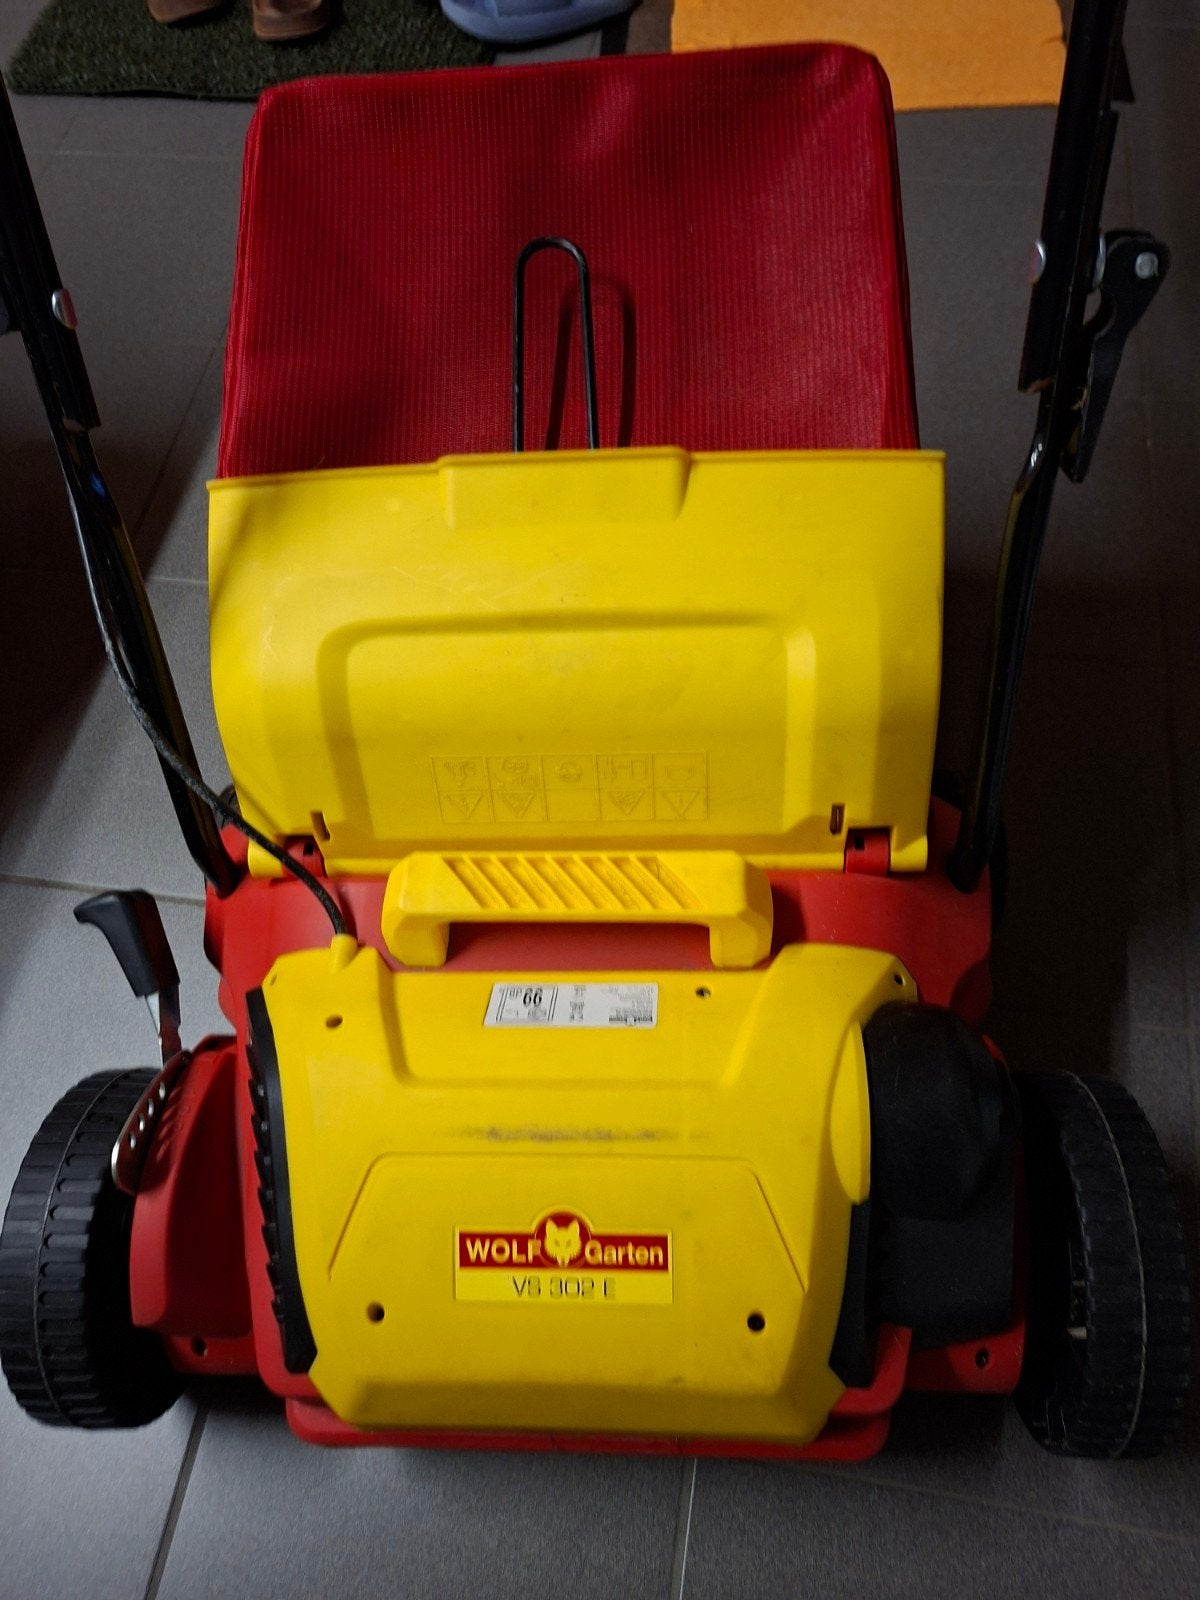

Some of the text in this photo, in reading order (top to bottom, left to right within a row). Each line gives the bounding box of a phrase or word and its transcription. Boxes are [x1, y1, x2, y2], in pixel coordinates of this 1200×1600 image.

[466, 1238, 663, 1265] WOLF Garten
[512, 1276, 541, 1299] VS
[550, 1277, 595, 1299] 302
